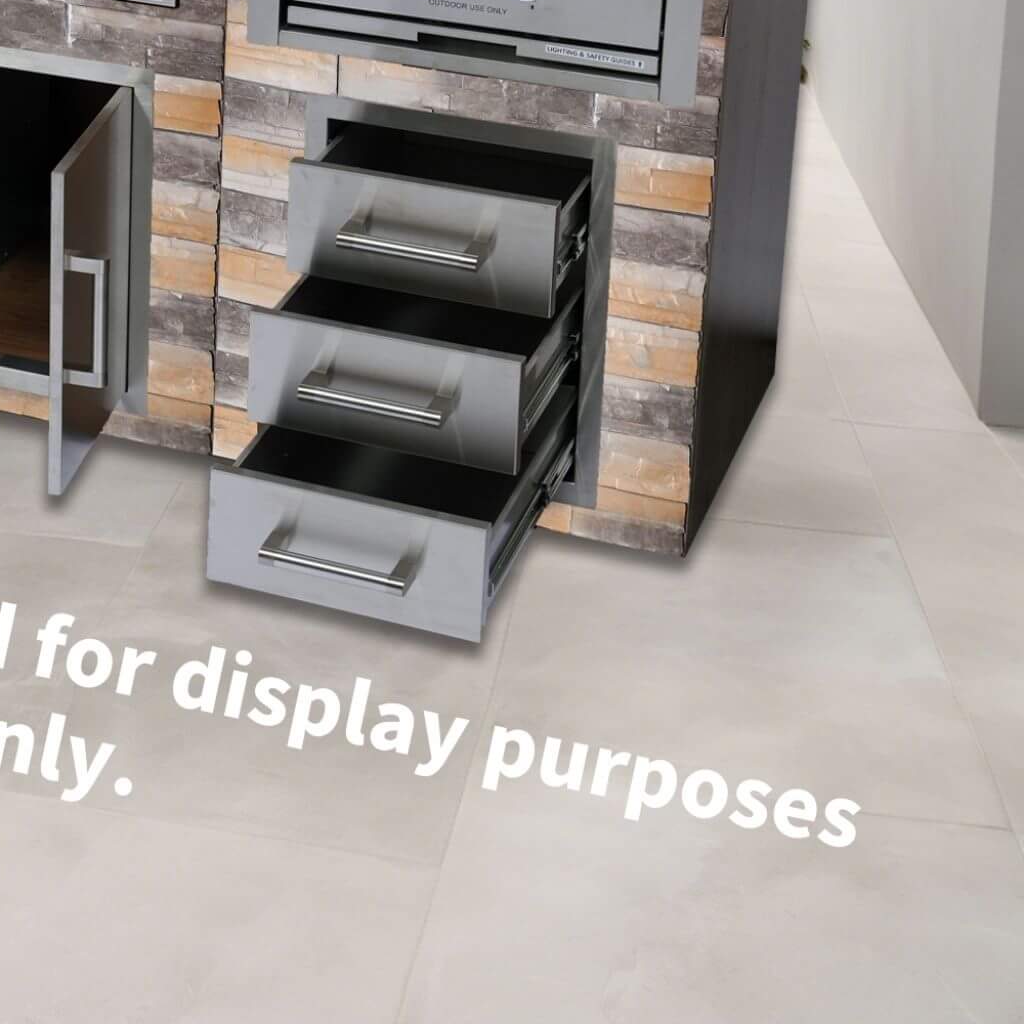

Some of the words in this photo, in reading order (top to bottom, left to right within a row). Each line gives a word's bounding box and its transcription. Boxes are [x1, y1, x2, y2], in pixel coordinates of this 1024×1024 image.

[469, 3, 485, 12] USE
[486, 5, 508, 16] ONLY
[546, 45, 578, 57] LIGHTING
[586, 52, 611, 63] SAFETY
